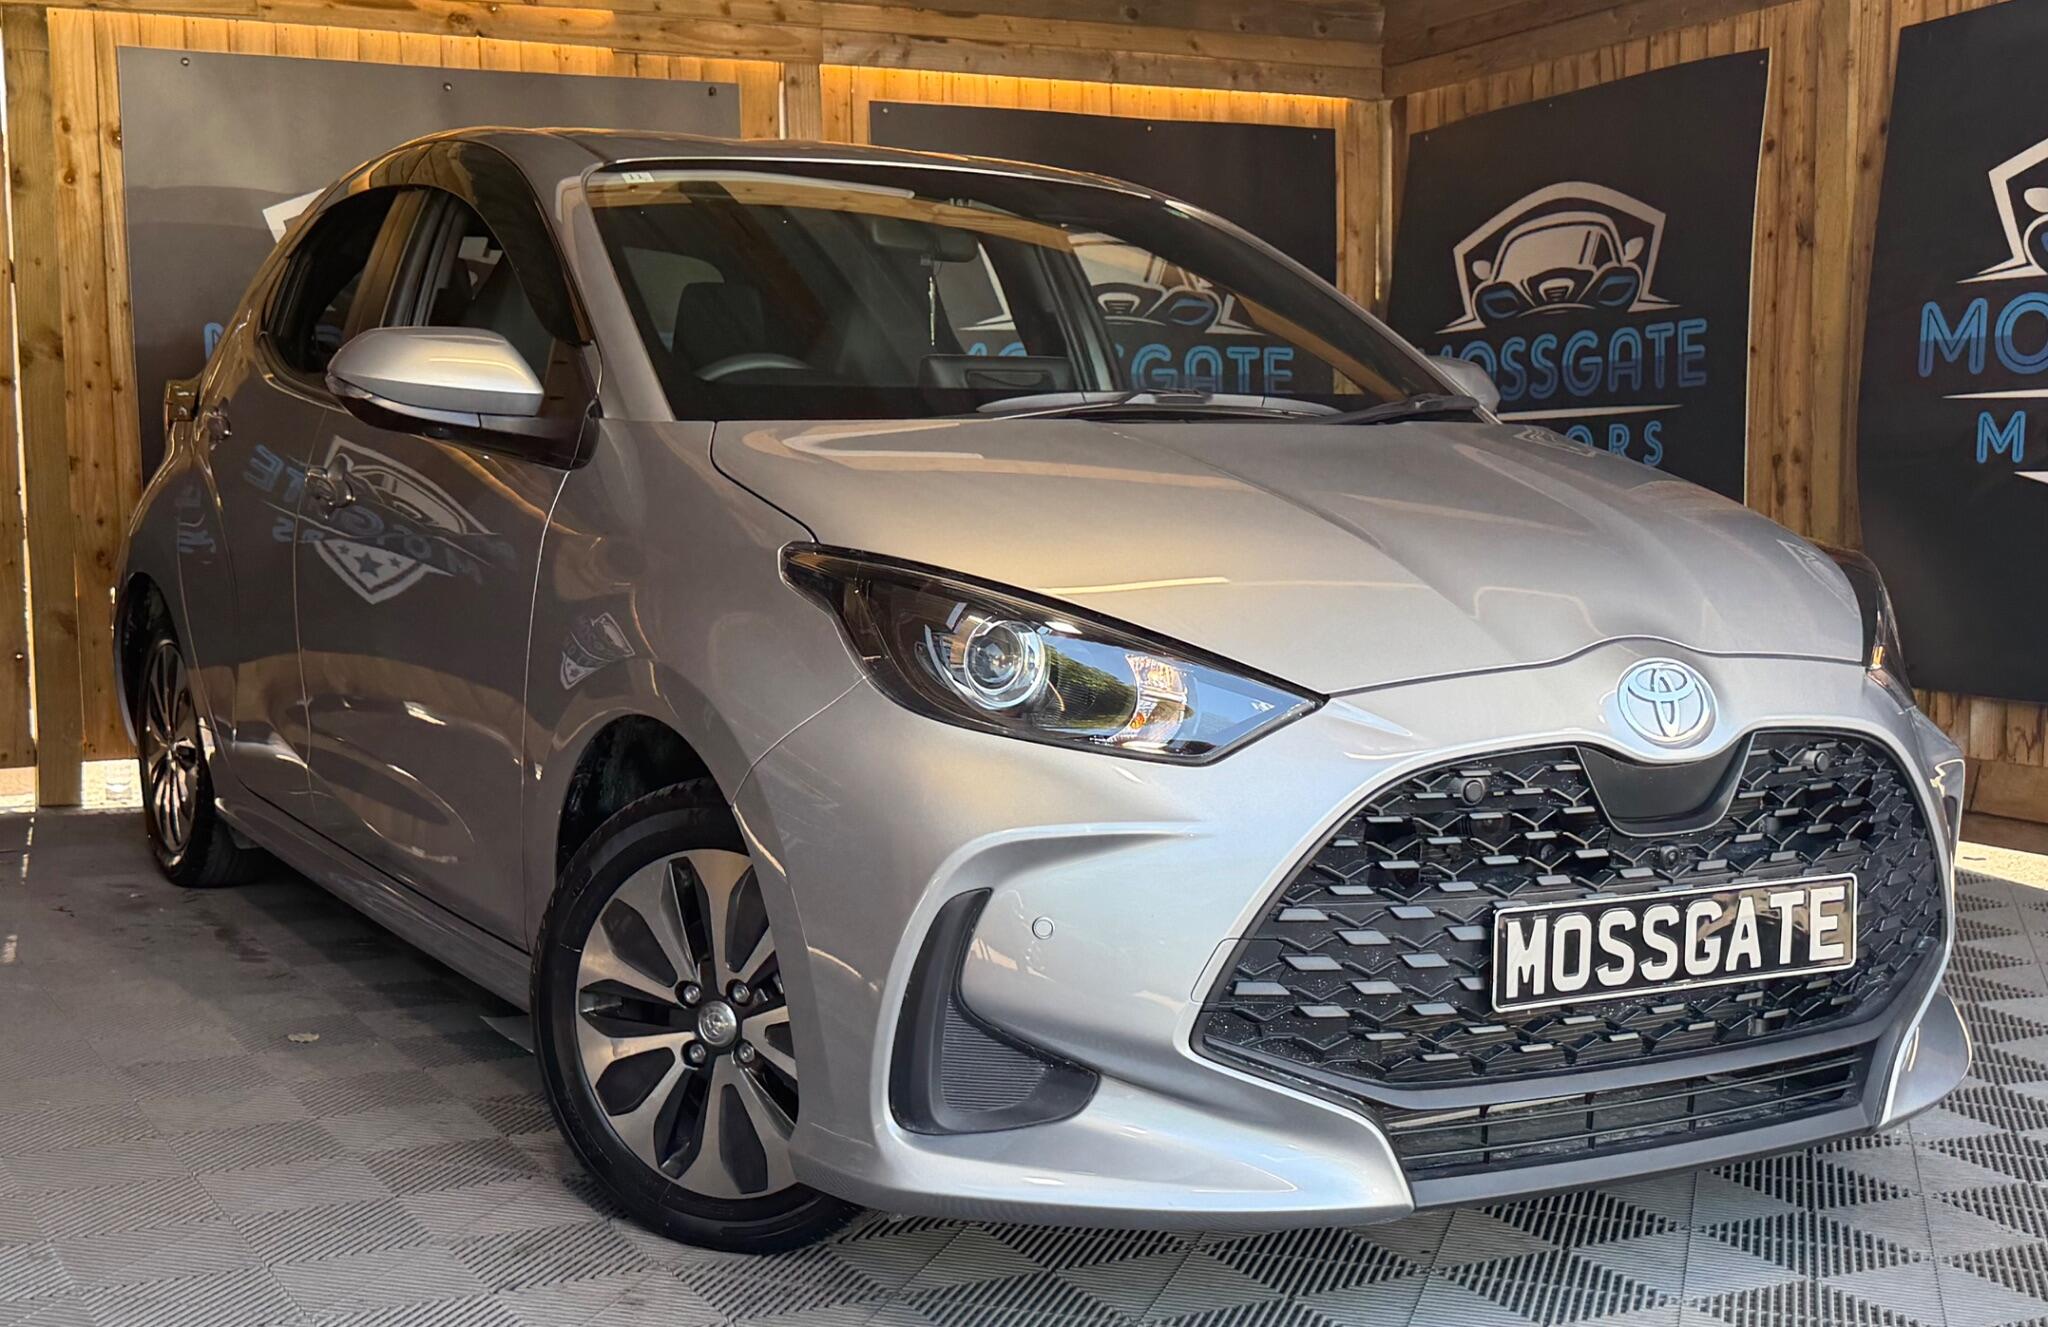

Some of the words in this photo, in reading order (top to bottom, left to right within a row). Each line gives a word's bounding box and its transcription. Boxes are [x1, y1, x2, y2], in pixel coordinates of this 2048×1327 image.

[1115, 343, 1294, 394] GATE
[1421, 318, 1708, 400] OSSGATE
[1505, 885, 1845, 999] MOSSGATE
